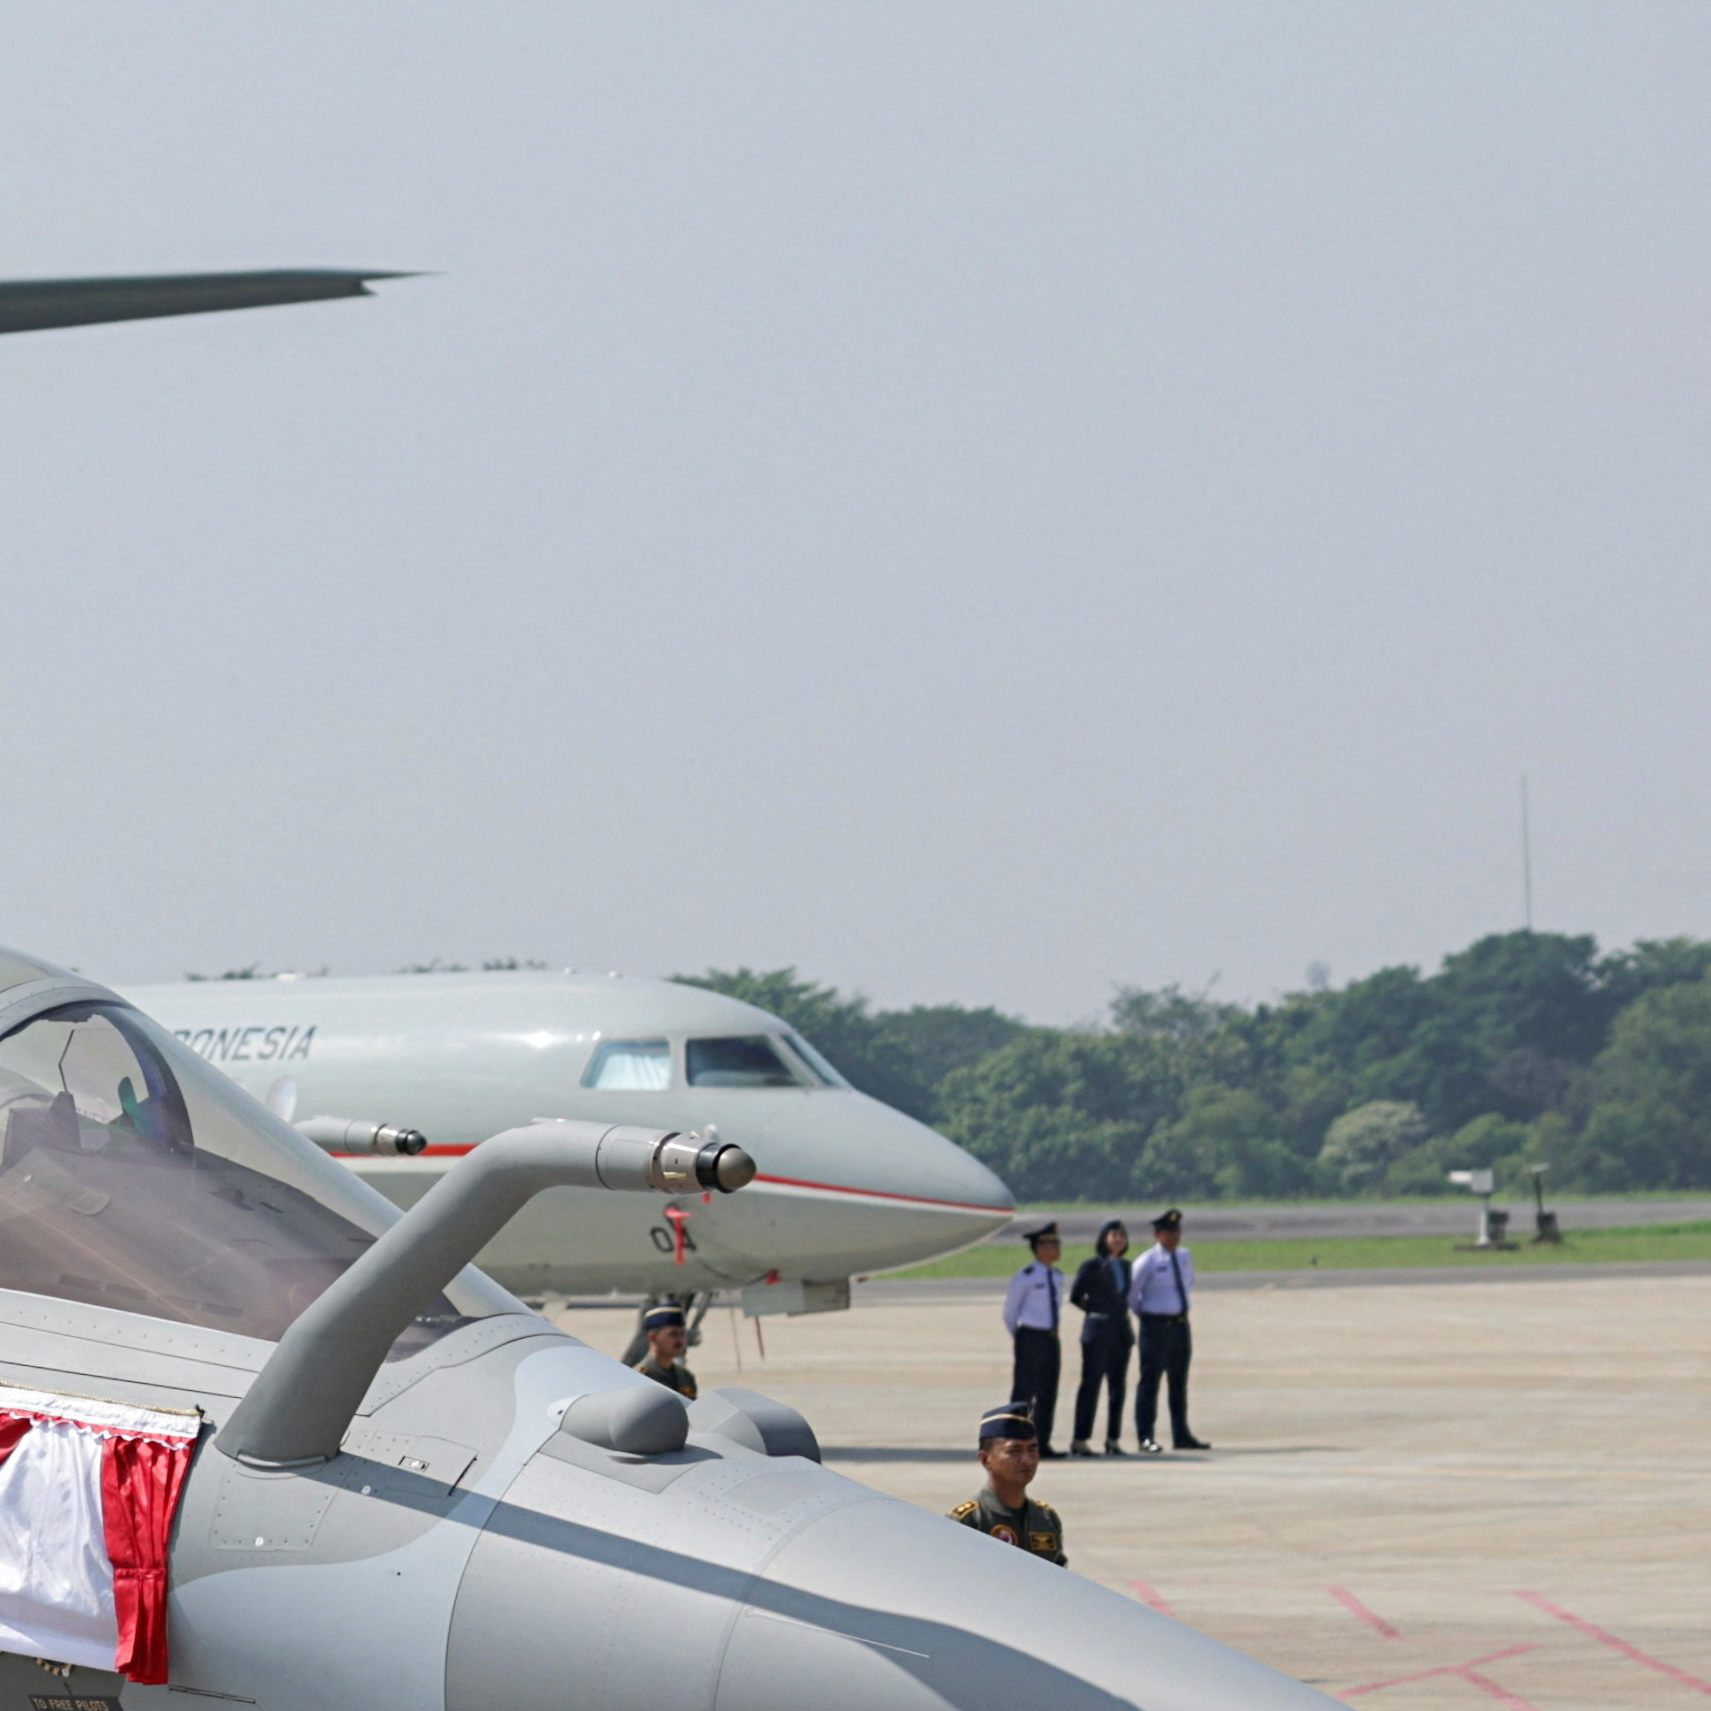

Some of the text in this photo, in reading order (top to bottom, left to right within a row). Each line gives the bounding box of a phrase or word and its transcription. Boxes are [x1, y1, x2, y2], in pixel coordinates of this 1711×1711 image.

[32, 1697, 110, 1711] TO FREE PILOTS
